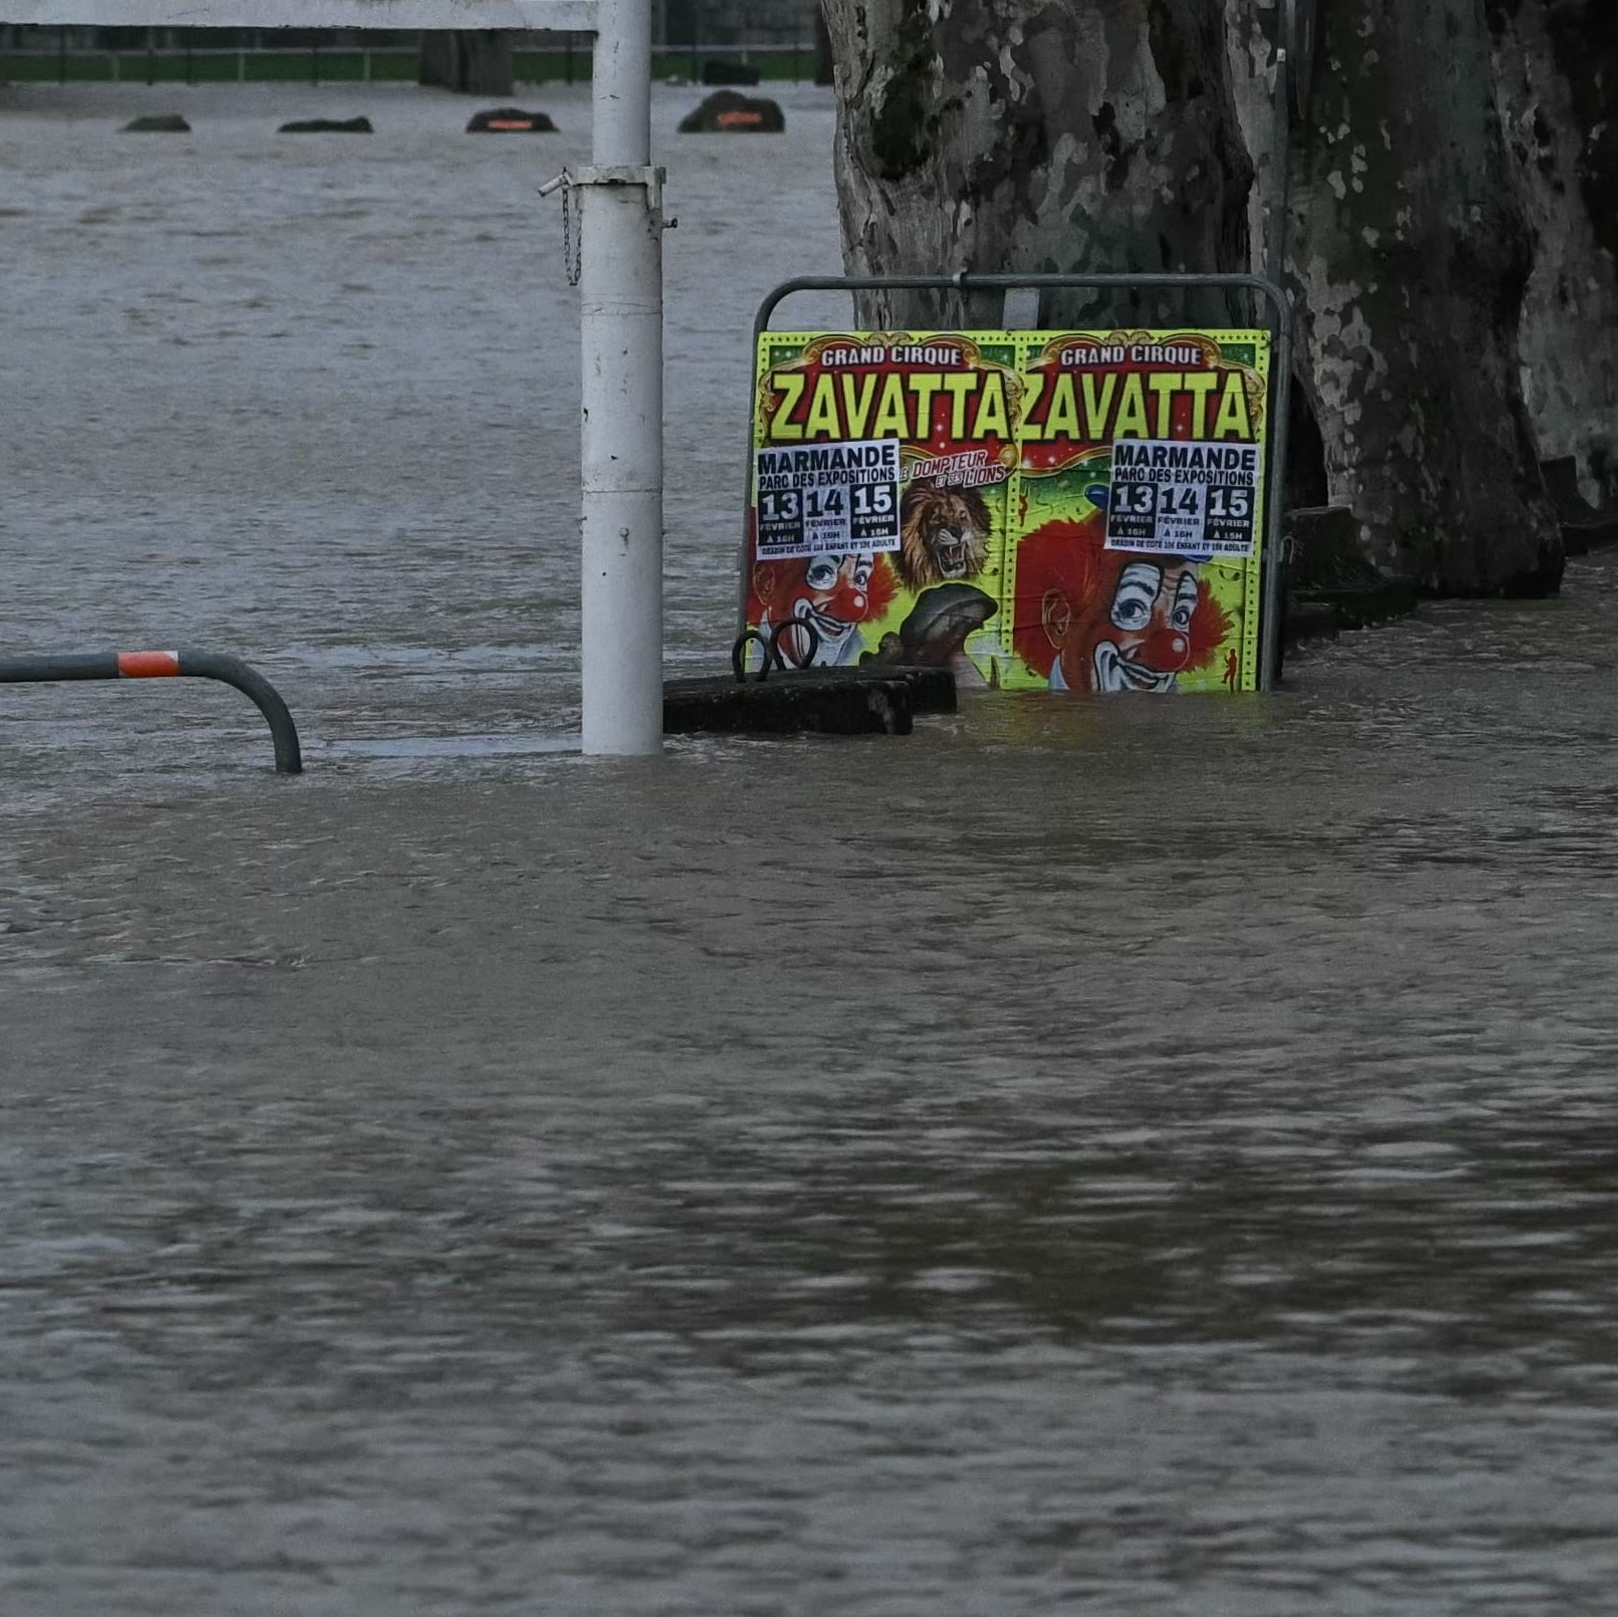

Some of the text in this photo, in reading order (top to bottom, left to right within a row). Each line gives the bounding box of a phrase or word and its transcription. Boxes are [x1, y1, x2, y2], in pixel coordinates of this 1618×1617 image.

[821, 345, 961, 367] GRAND CIRQUE
[1061, 345, 1202, 366] GRAND CIRQUE
[770, 372, 1010, 440] ZAVATTA
[1021, 372, 1250, 440] ZAVATTA
[758, 444, 895, 475] MARMANDE
[912, 450, 987, 478] DOMPTEUR
[1114, 444, 1256, 471] MARMANDE
[759, 467, 895, 490] PARC DES EXPOSITIONS
[964, 465, 1006, 487] LIONS
[1115, 467, 1254, 486] PARC DES EXPOSITIONS
[762, 485, 892, 521] 13 14 15
[1115, 485, 1248, 517] 13 14 15
[1176, 542, 1201, 551] ENFANT
[1224, 544, 1248, 553] ADULTE
